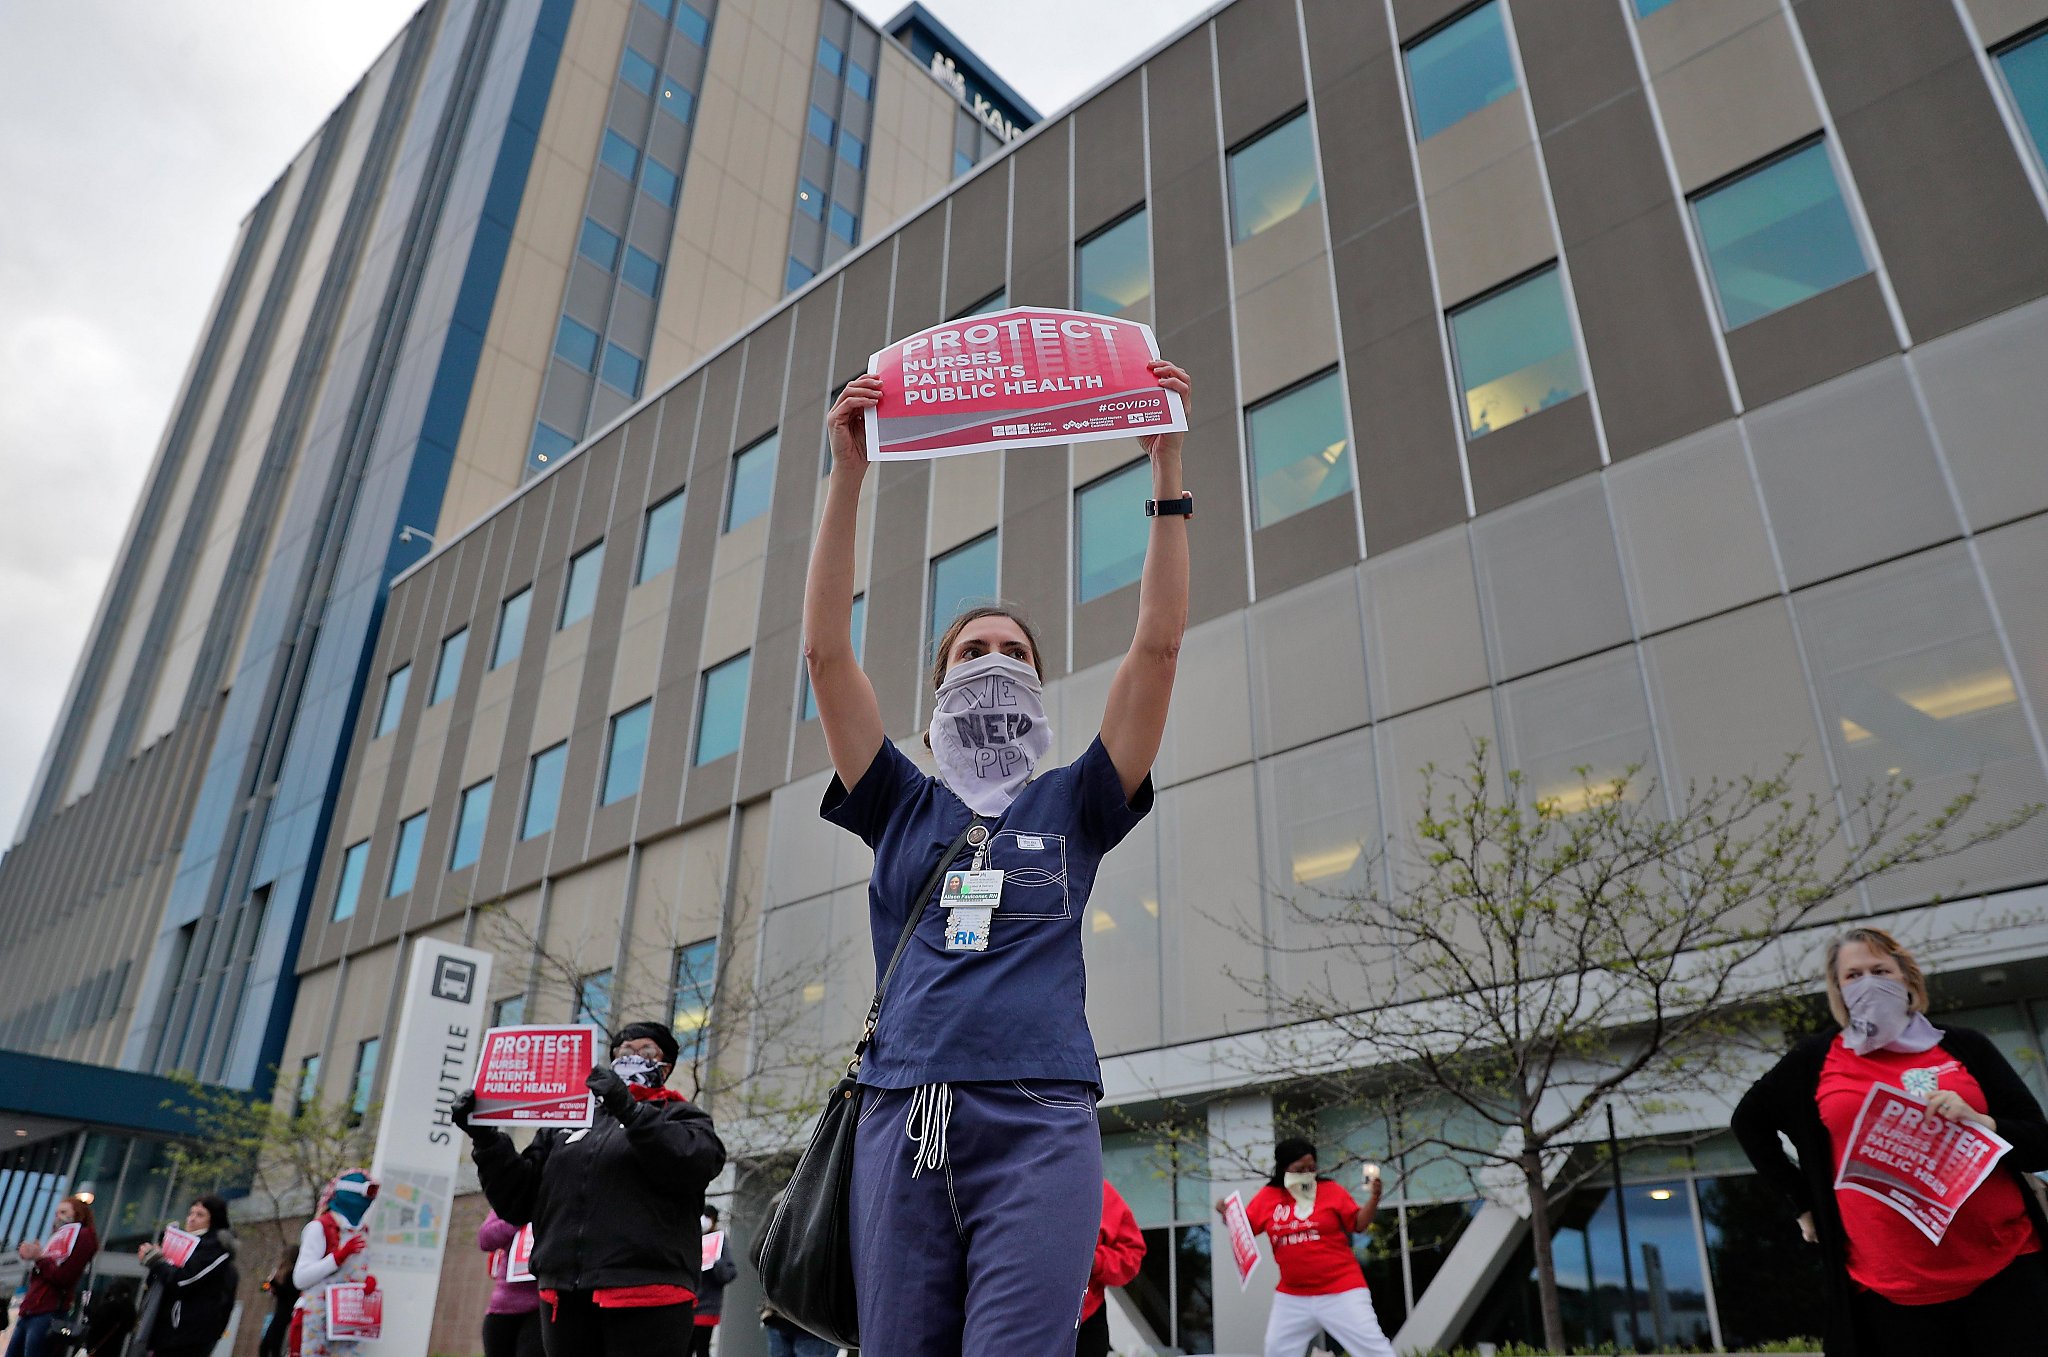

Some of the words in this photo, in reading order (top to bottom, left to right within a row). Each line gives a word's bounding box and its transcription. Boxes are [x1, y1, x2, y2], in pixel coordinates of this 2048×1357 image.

[902, 318, 1118, 356] PROTECT
[902, 351, 1002, 373] NURSES
[903, 364, 1026, 387] PATIENTS
[905, 383, 997, 406] PUBLIC
[1004, 375, 1103, 396] HEALTH
[1098, 399, 1161, 413] #COVID19
[953, 711, 1033, 749] NEED
[491, 1034, 583, 1054] PROTECT
[486, 1070, 536, 1082] PATIENTS
[488, 1059, 529, 1070] NURSES
[429, 1024, 469, 1146] SHUTTLE
[483, 1082, 522, 1093] PUBLIC
[523, 1082, 567, 1093] HEALTH
[1871, 1122, 1932, 1152] NURSES
[1859, 1145, 1912, 1173] PUBLIC
[1865, 1133, 1938, 1171] PATIENTS
